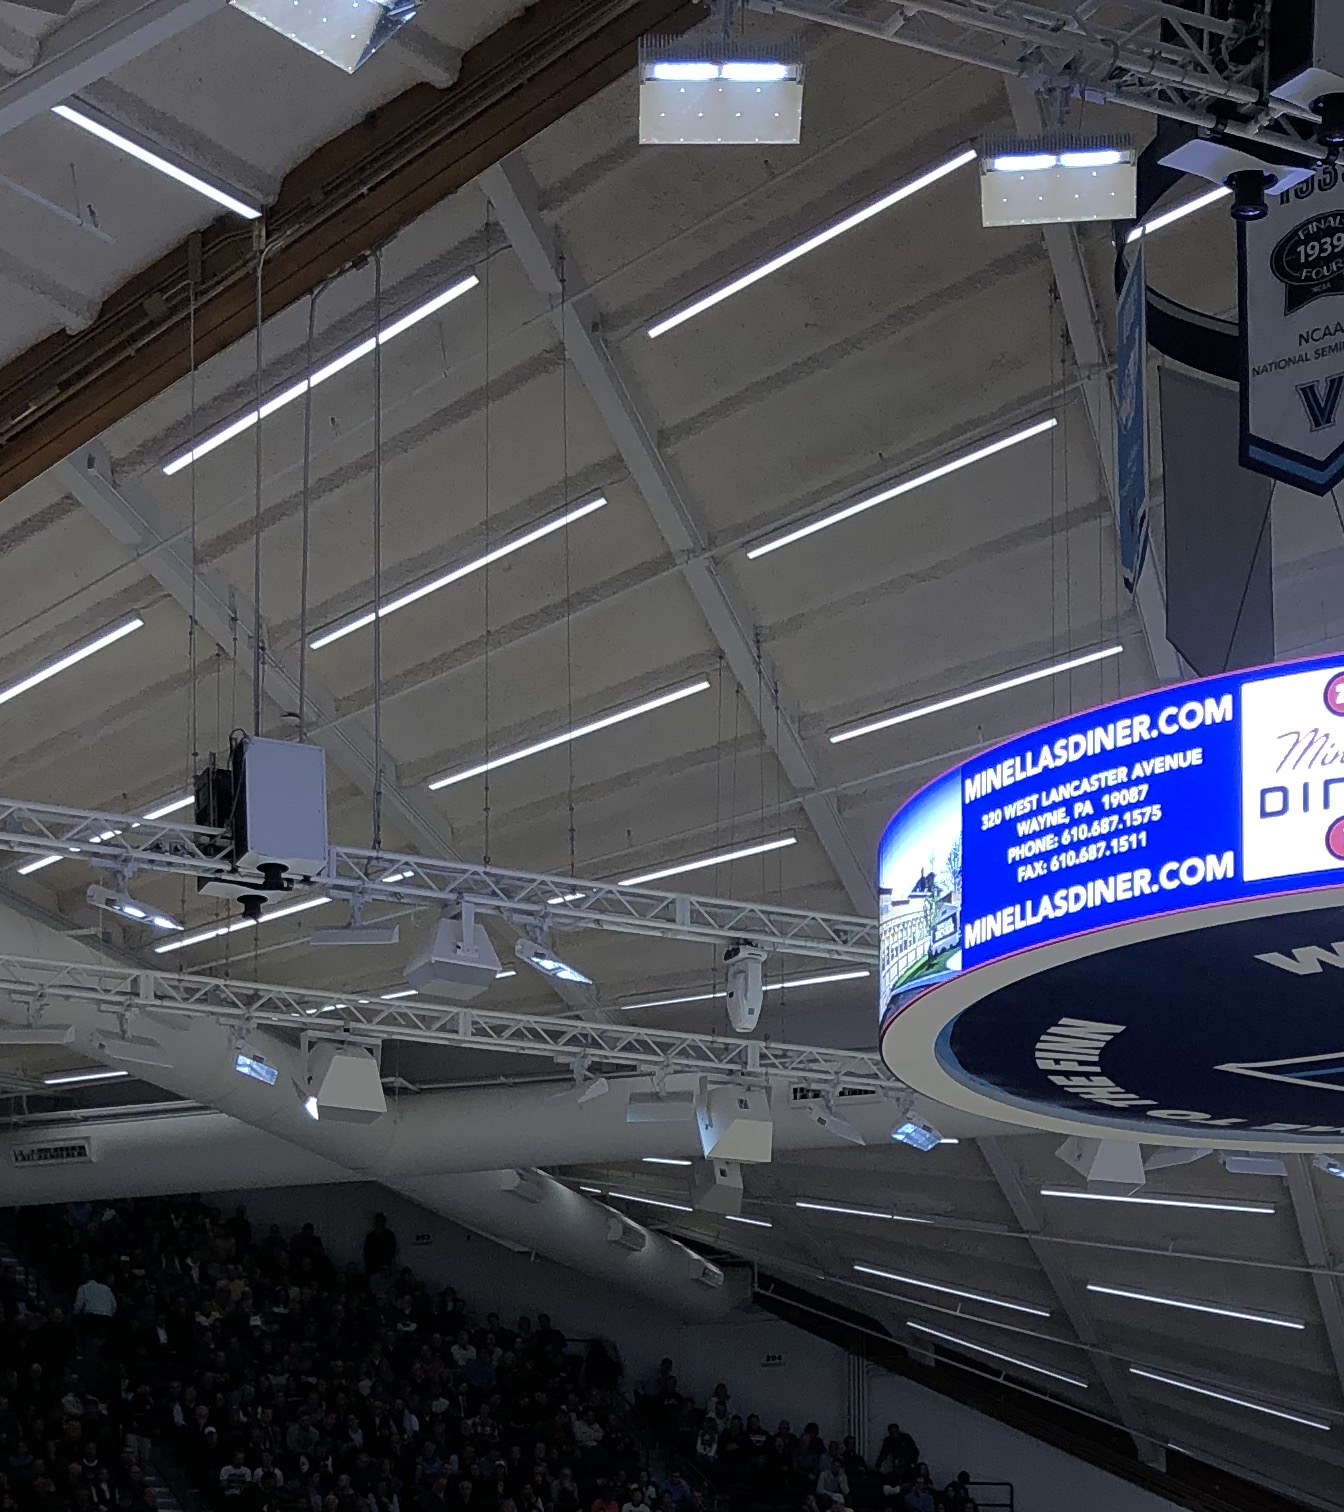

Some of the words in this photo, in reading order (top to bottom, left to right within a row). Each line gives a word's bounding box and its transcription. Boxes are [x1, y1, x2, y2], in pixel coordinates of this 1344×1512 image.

[1296, 214, 1344, 241] FINAL
[1251, 350, 1312, 379] NATIONAL
[963, 693, 1234, 804] MINELLASDINER.COM
[981, 809, 1003, 831] 320
[1003, 793, 1040, 821] WEST
[1041, 765, 1129, 808] LANCASTER
[1131, 747, 1204, 781] AVENUE
[1016, 806, 1071, 838] WAYNE,
[1074, 799, 1095, 819] PA
[1101, 783, 1150, 811] 19087
[1007, 833, 1060, 865] PHONE:
[1060, 803, 1163, 846] 610.687.1575
[1017, 860, 1049, 883] FAX:
[1049, 830, 1148, 873] 610.687.1511
[963, 850, 1236, 950] MINELLASDINER.COM
